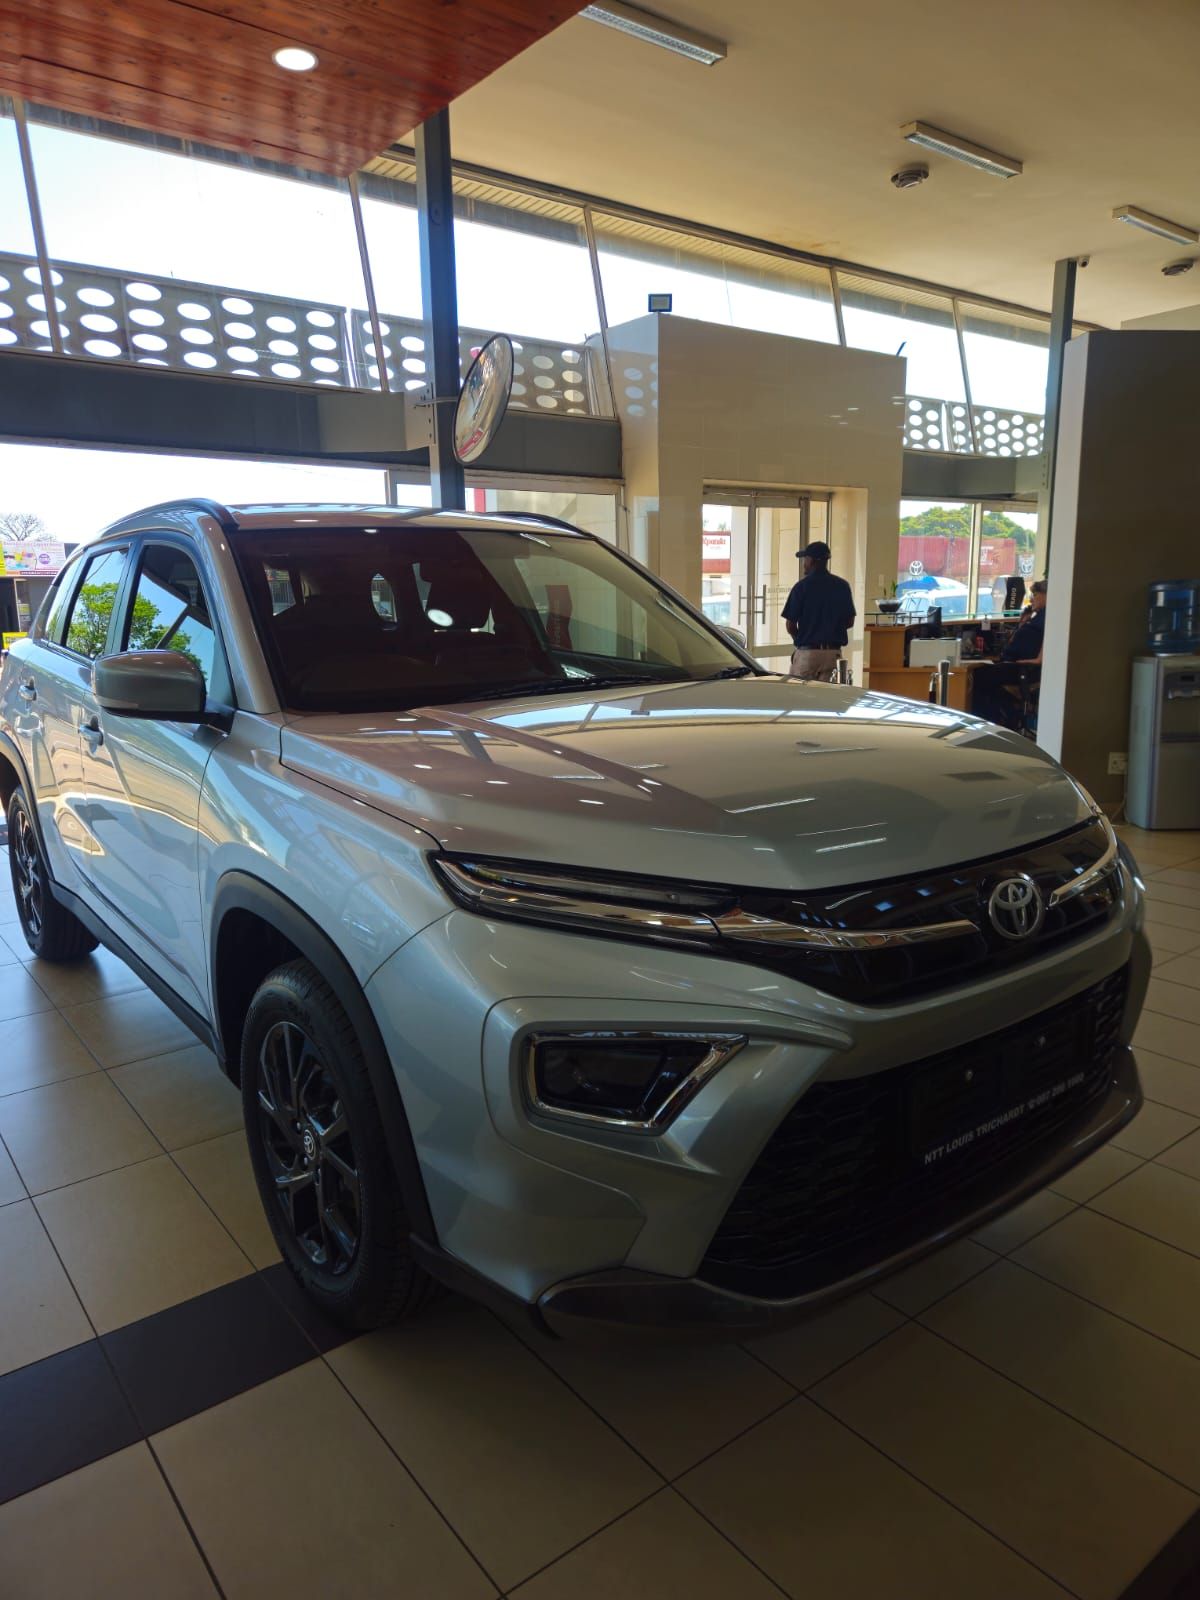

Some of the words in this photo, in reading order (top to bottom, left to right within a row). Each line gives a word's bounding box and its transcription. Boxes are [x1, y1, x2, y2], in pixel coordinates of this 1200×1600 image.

[924, 1146, 945, 1165] NTT
[946, 1130, 975, 1153] LOUIS
[975, 1104, 1025, 1137] TRICHARDT
